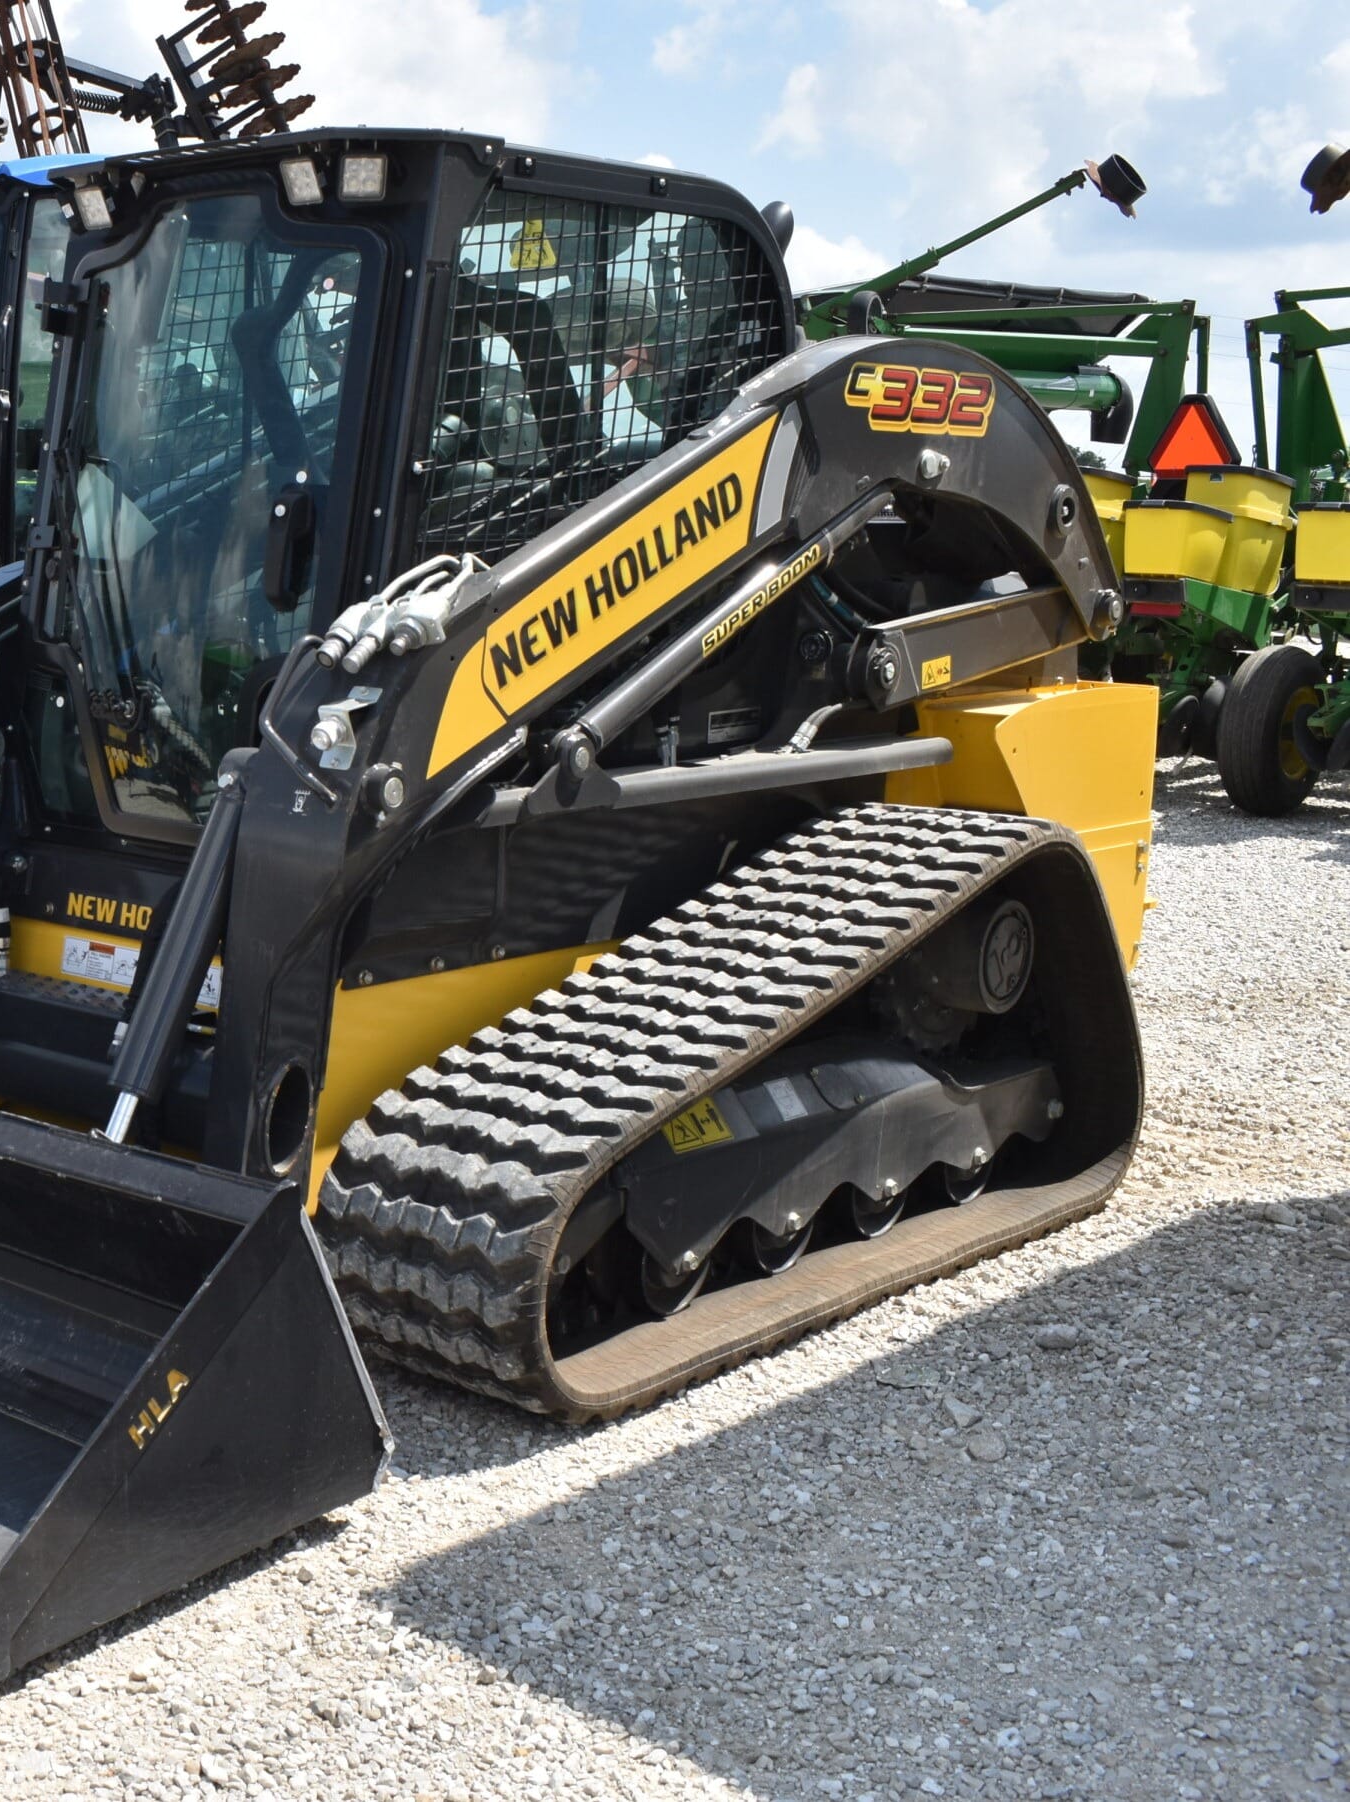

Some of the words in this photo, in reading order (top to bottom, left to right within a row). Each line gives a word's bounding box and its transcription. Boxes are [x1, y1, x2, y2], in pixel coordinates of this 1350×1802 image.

[845, 362, 996, 437] C332
[489, 588, 578, 690] NEW
[584, 472, 743, 621] HOLLAND
[702, 591, 767, 656] SUPER
[767, 544, 821, 602] BOOM
[67, 892, 118, 924] NEW
[128, 1368, 190, 1450] HLA
